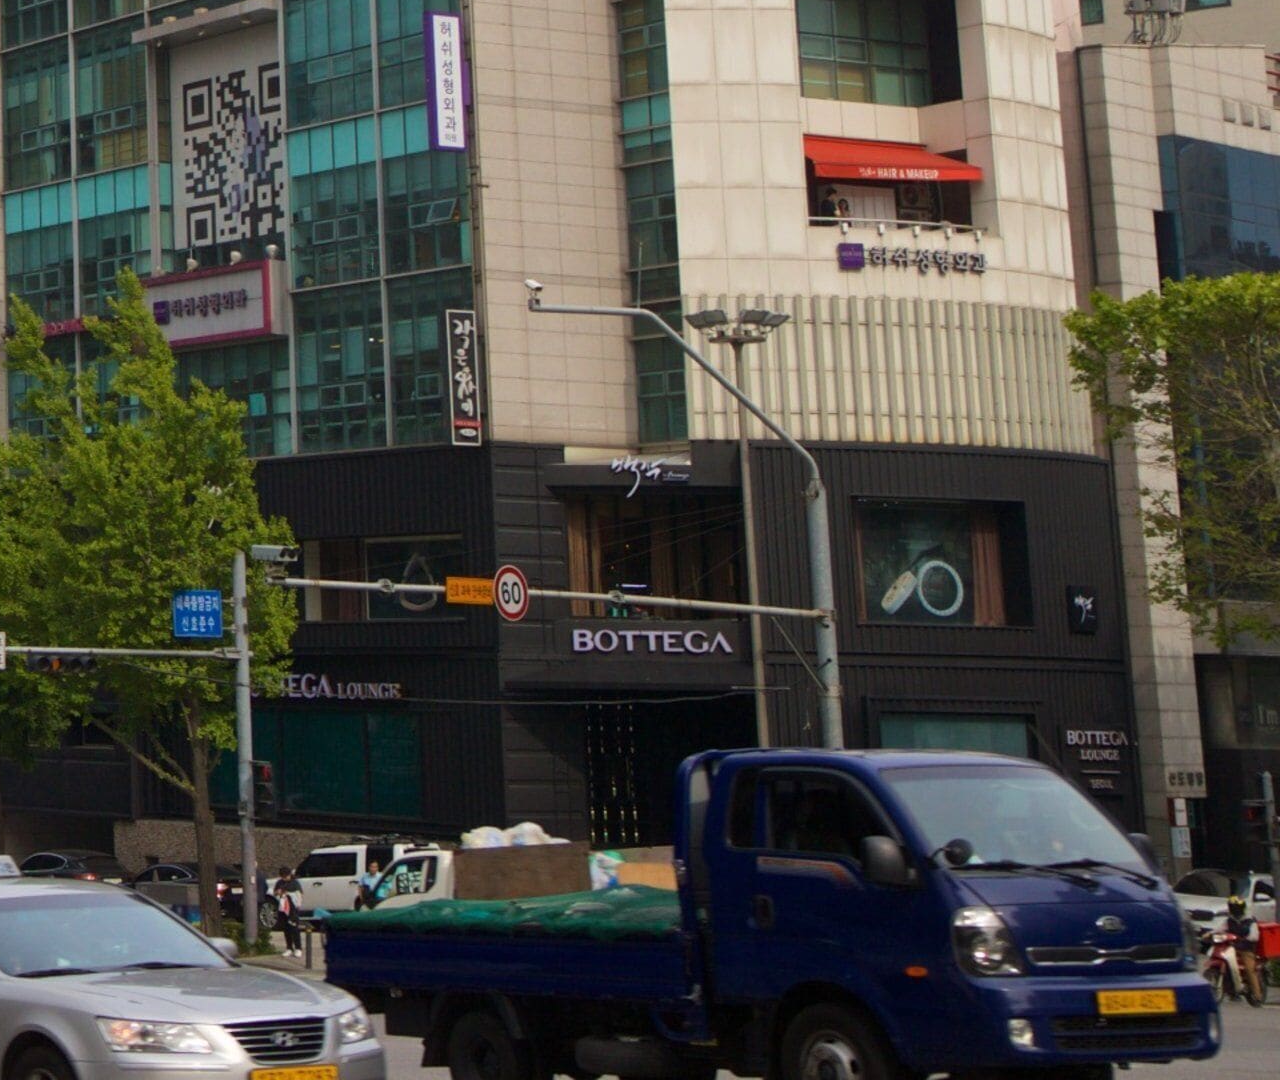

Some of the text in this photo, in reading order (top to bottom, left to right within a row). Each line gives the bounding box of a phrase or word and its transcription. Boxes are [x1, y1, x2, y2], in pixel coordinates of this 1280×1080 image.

[440, 21, 457, 133] 허쉬성형외과
[877, 168, 897, 178] HAIR
[906, 169, 940, 179] MAKEUP
[869, 247, 986, 275] 허쉬성형외과
[502, 581, 521, 604] 60
[573, 628, 733, 655] BOTTEGA
[337, 682, 401, 700] LOUNGE
[1067, 730, 1128, 746] BOTTEGA
[1080, 749, 1120, 761] LOUNGE
